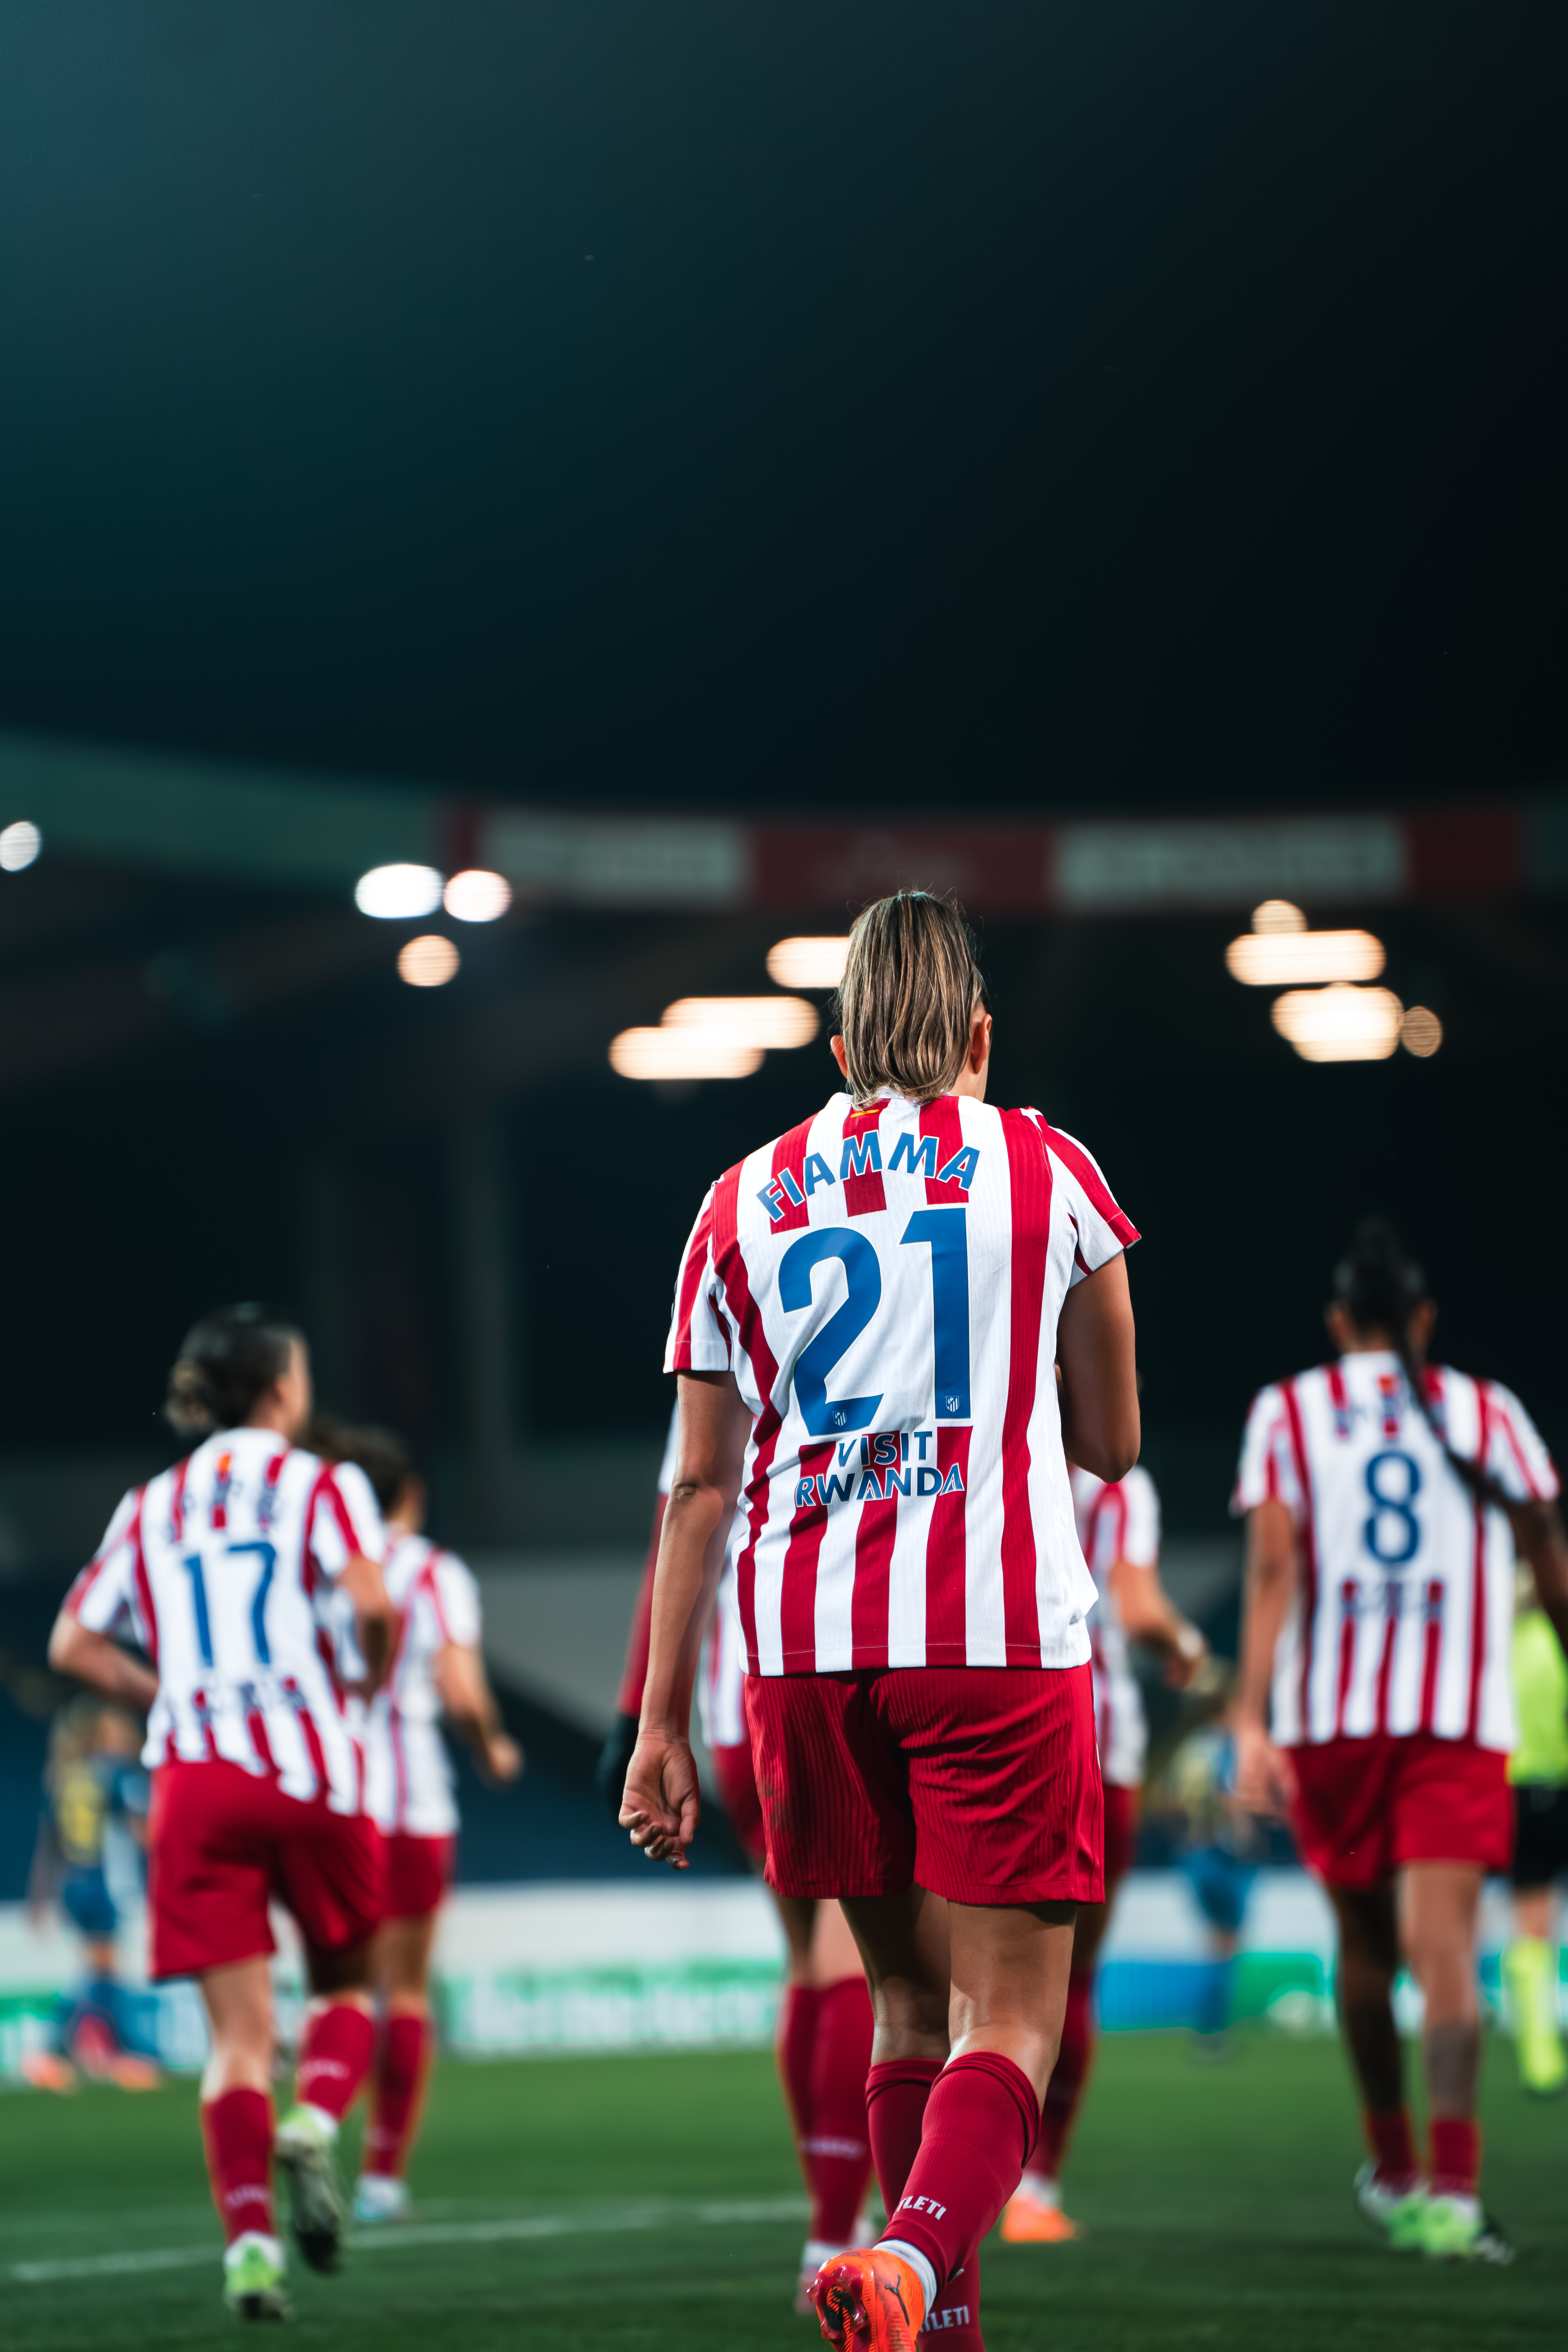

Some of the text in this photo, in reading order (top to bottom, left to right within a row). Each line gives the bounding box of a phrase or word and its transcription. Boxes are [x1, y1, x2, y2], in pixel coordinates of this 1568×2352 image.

[756, 1130, 980, 1223] FIAMMA
[778, 1206, 972, 1436] 21
[839, 1431, 933, 1467] VISIT
[795, 1463, 965, 1507] RWANDA
[1366, 1450, 1419, 1564] 8
[183, 1542, 276, 1667] 17
[893, 2196, 947, 2221] TLETI
[920, 2305, 969, 2332] TLETI
